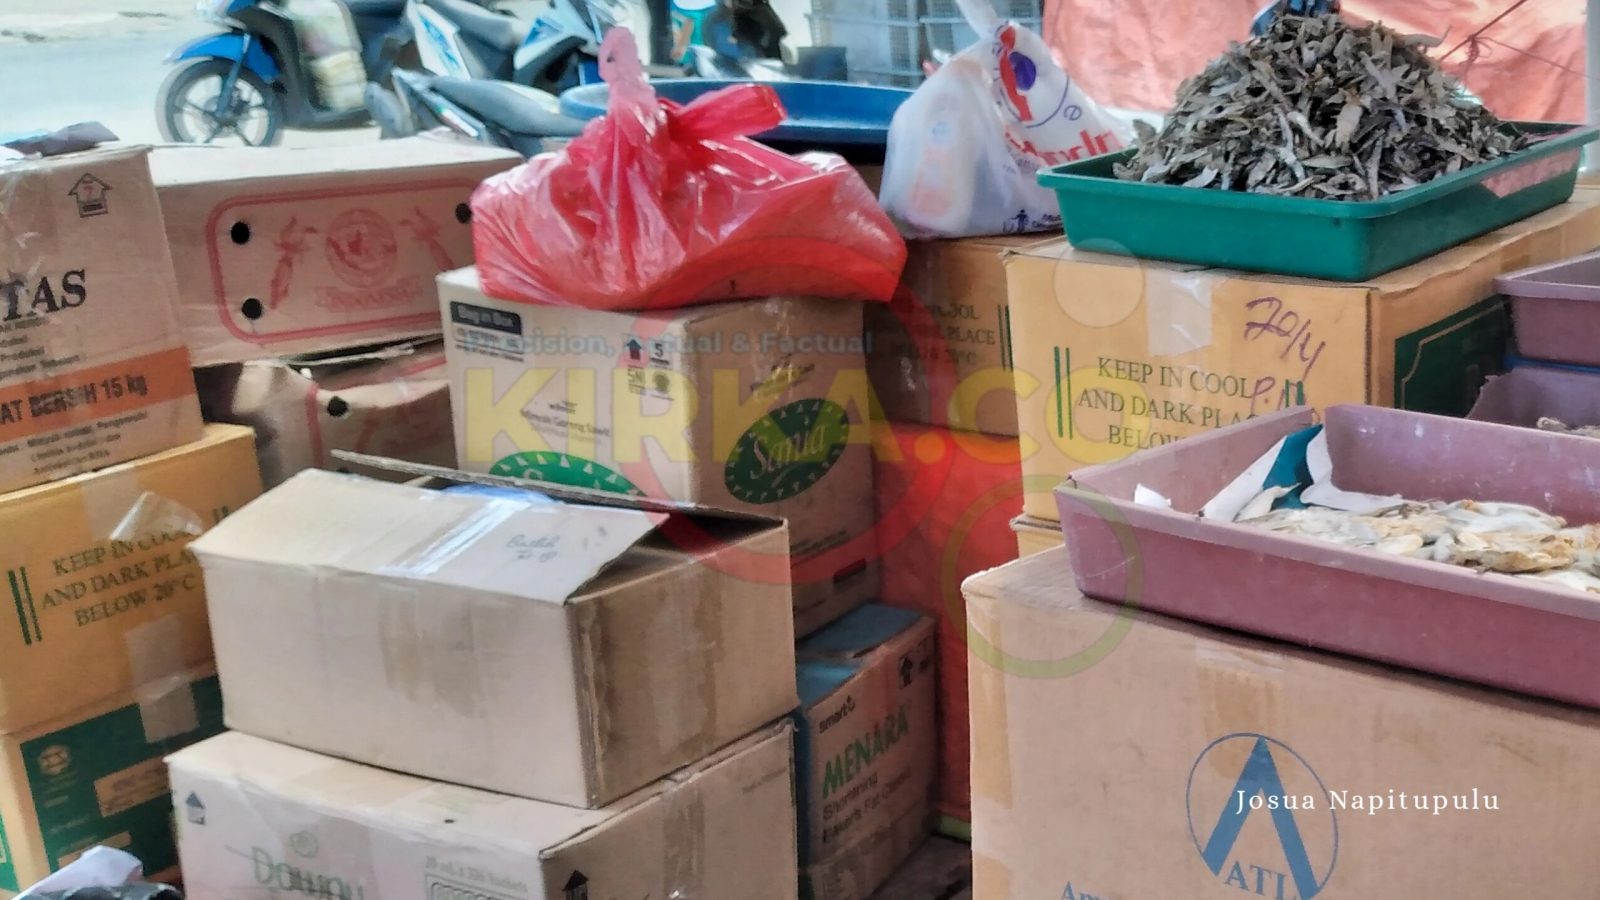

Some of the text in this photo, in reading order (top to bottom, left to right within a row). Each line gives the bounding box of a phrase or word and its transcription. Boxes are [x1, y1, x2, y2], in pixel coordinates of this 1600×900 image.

[101, 376, 124, 400] 15
[1097, 356, 1253, 399] KEEP IN COOL
[1077, 388, 1125, 413] AND
[1131, 394, 1196, 425] DARK
[52, 547, 107, 577] KEEP
[111, 539, 134, 560] IN
[41, 580, 88, 611] AND
[90, 560, 150, 594] DARK
[74, 588, 147, 627] BELOW
[822, 705, 909, 798] MENARA
